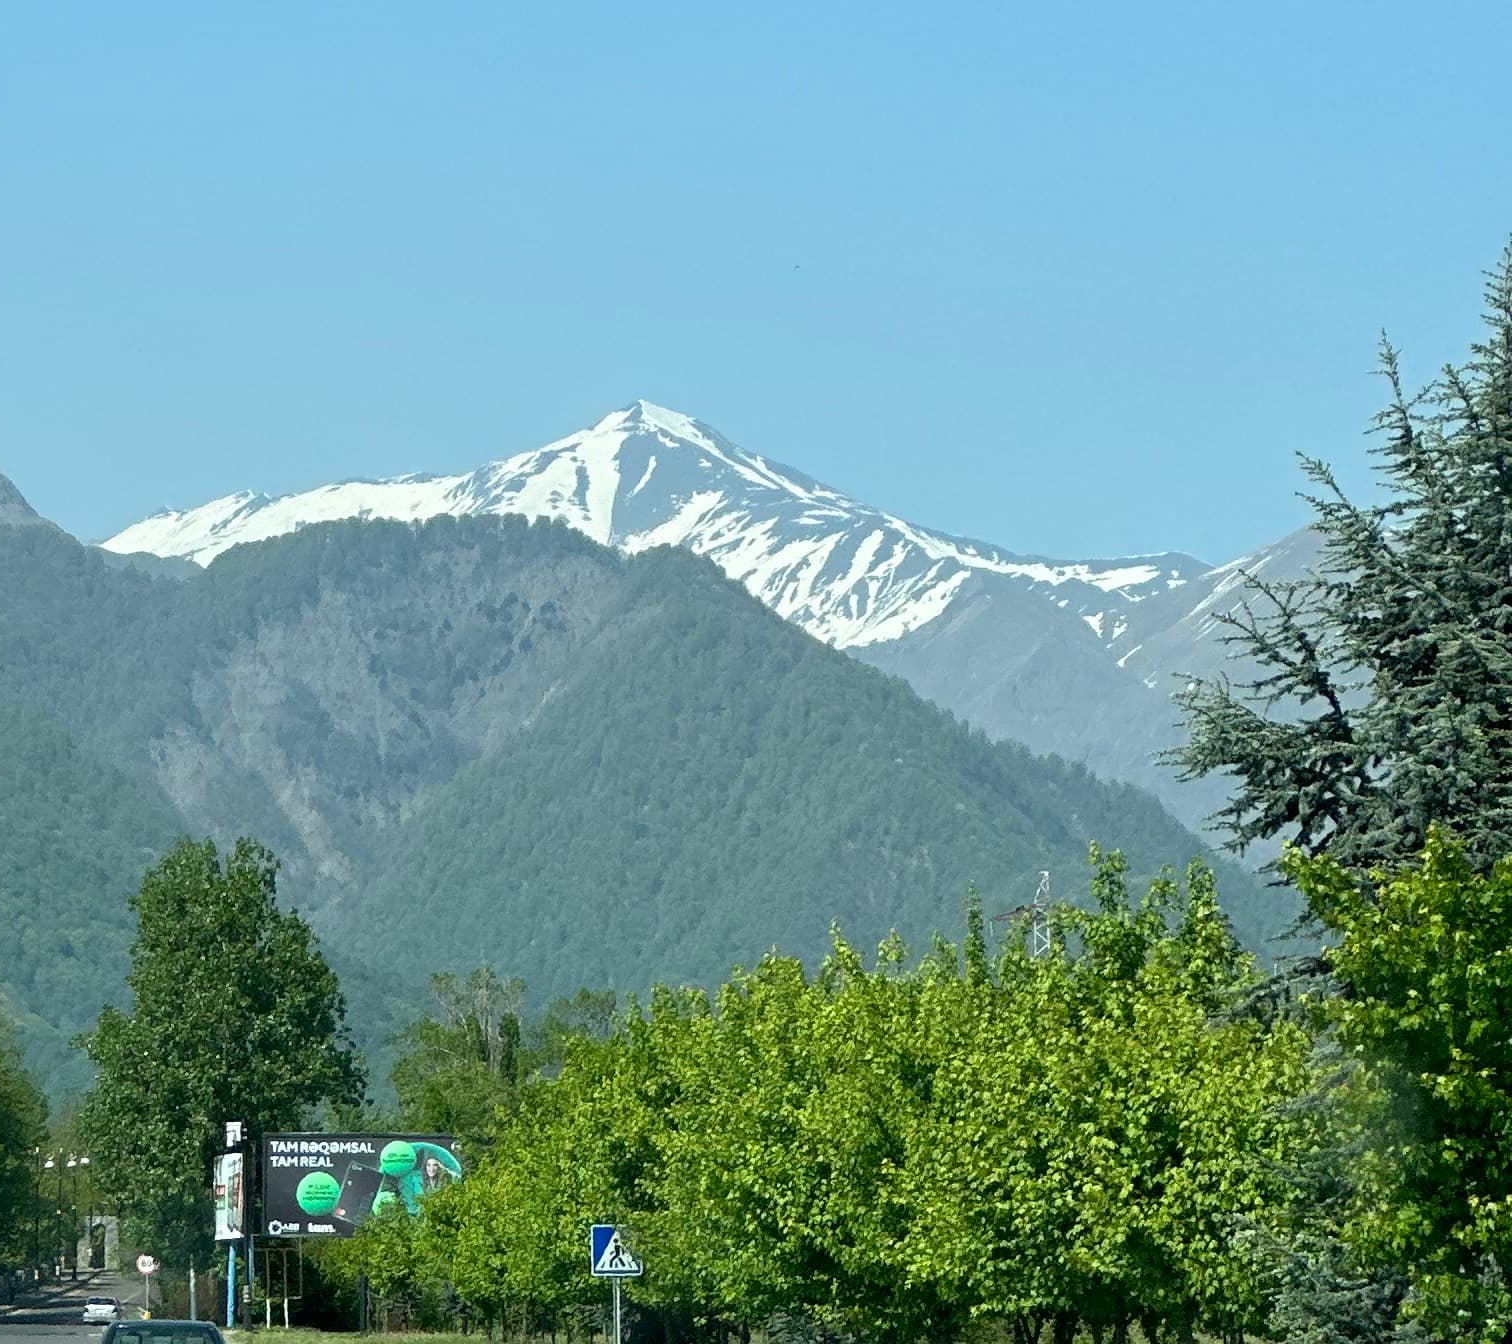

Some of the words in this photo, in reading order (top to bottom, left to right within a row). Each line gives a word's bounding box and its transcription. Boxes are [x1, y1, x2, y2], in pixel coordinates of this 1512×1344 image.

[270, 1141, 298, 1153] TAM
[300, 1141, 375, 1155] RƏQƏMSAL
[270, 1156, 298, 1167] TAM
[300, 1156, 334, 1167] REAL
